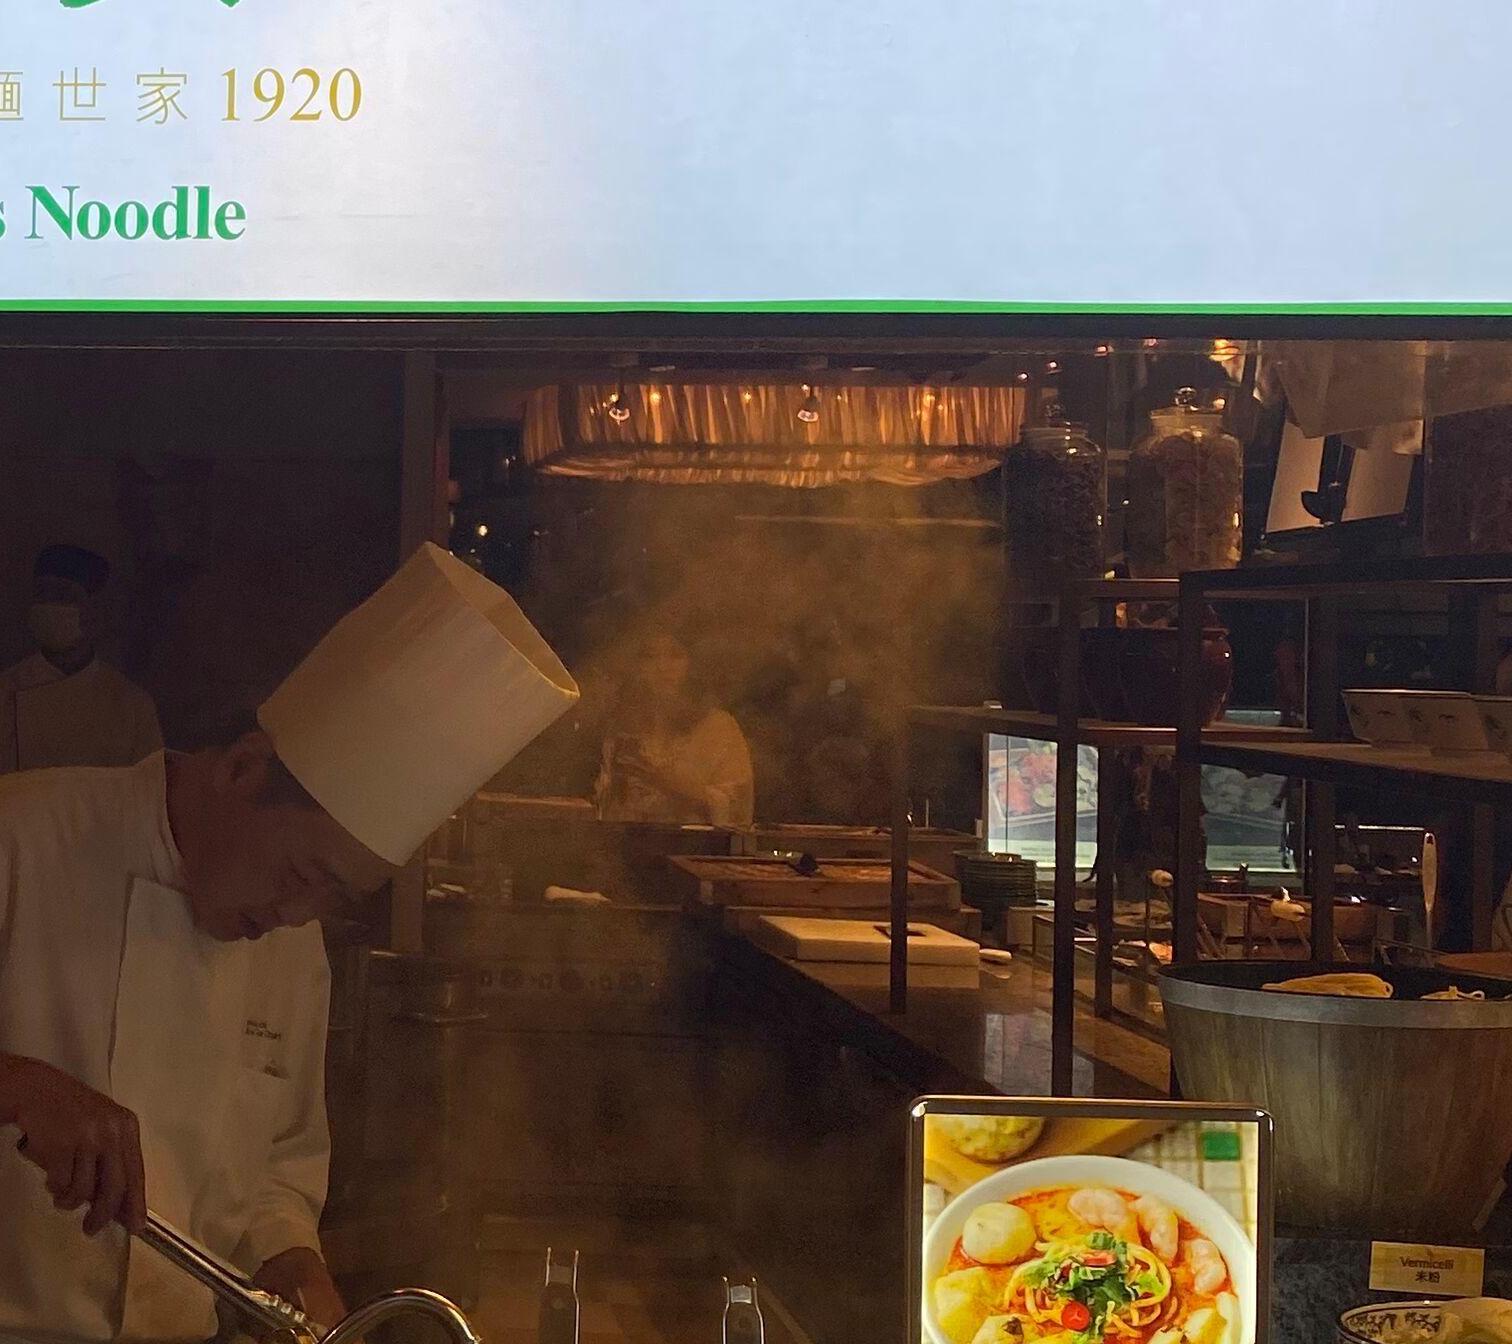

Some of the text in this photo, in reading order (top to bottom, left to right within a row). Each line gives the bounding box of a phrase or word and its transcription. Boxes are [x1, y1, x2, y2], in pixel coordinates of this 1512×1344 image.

[218, 67, 364, 122] 1920
[25, 185, 247, 241] Noodle
[1399, 1255, 1455, 1270] Vermicelli
